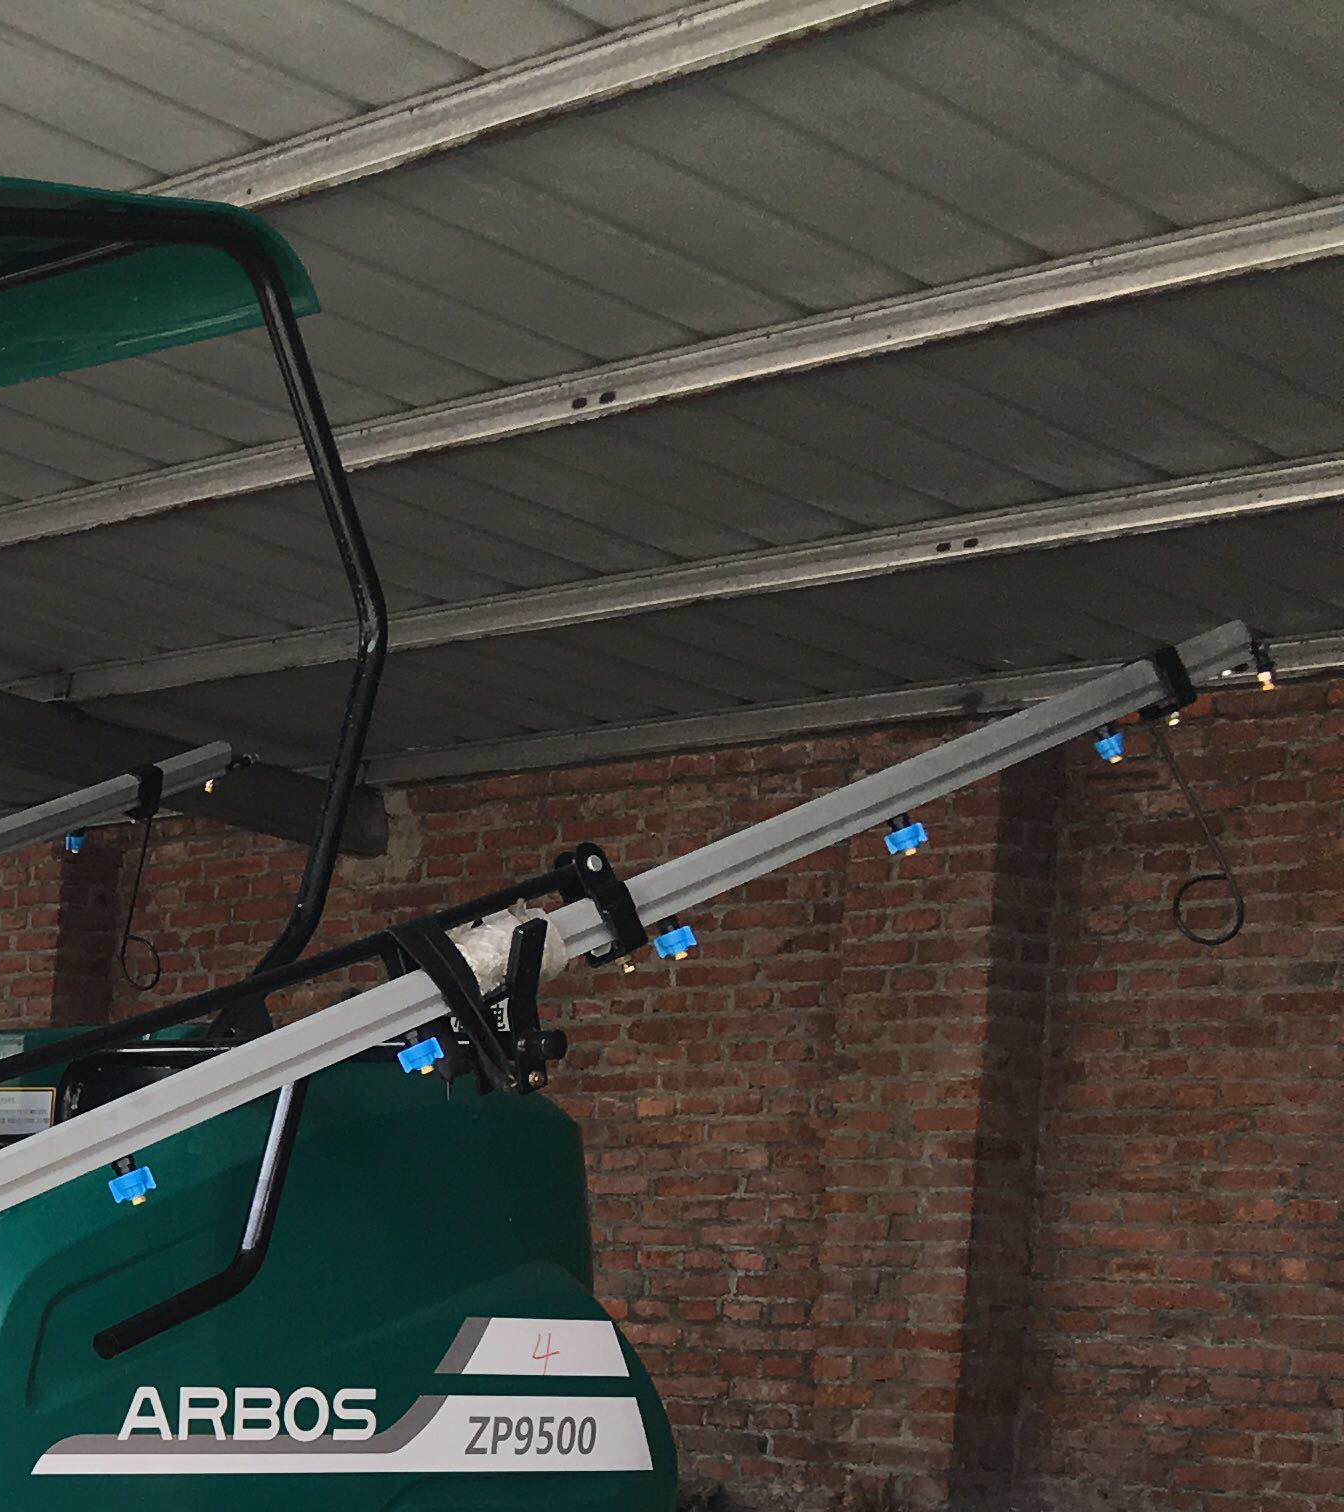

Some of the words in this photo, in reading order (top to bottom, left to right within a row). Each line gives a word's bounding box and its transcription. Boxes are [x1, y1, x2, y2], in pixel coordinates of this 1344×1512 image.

[531, 1331, 560, 1376] 4
[116, 1386, 377, 1442] ARBOS
[464, 1416, 598, 1456] ZP9500
